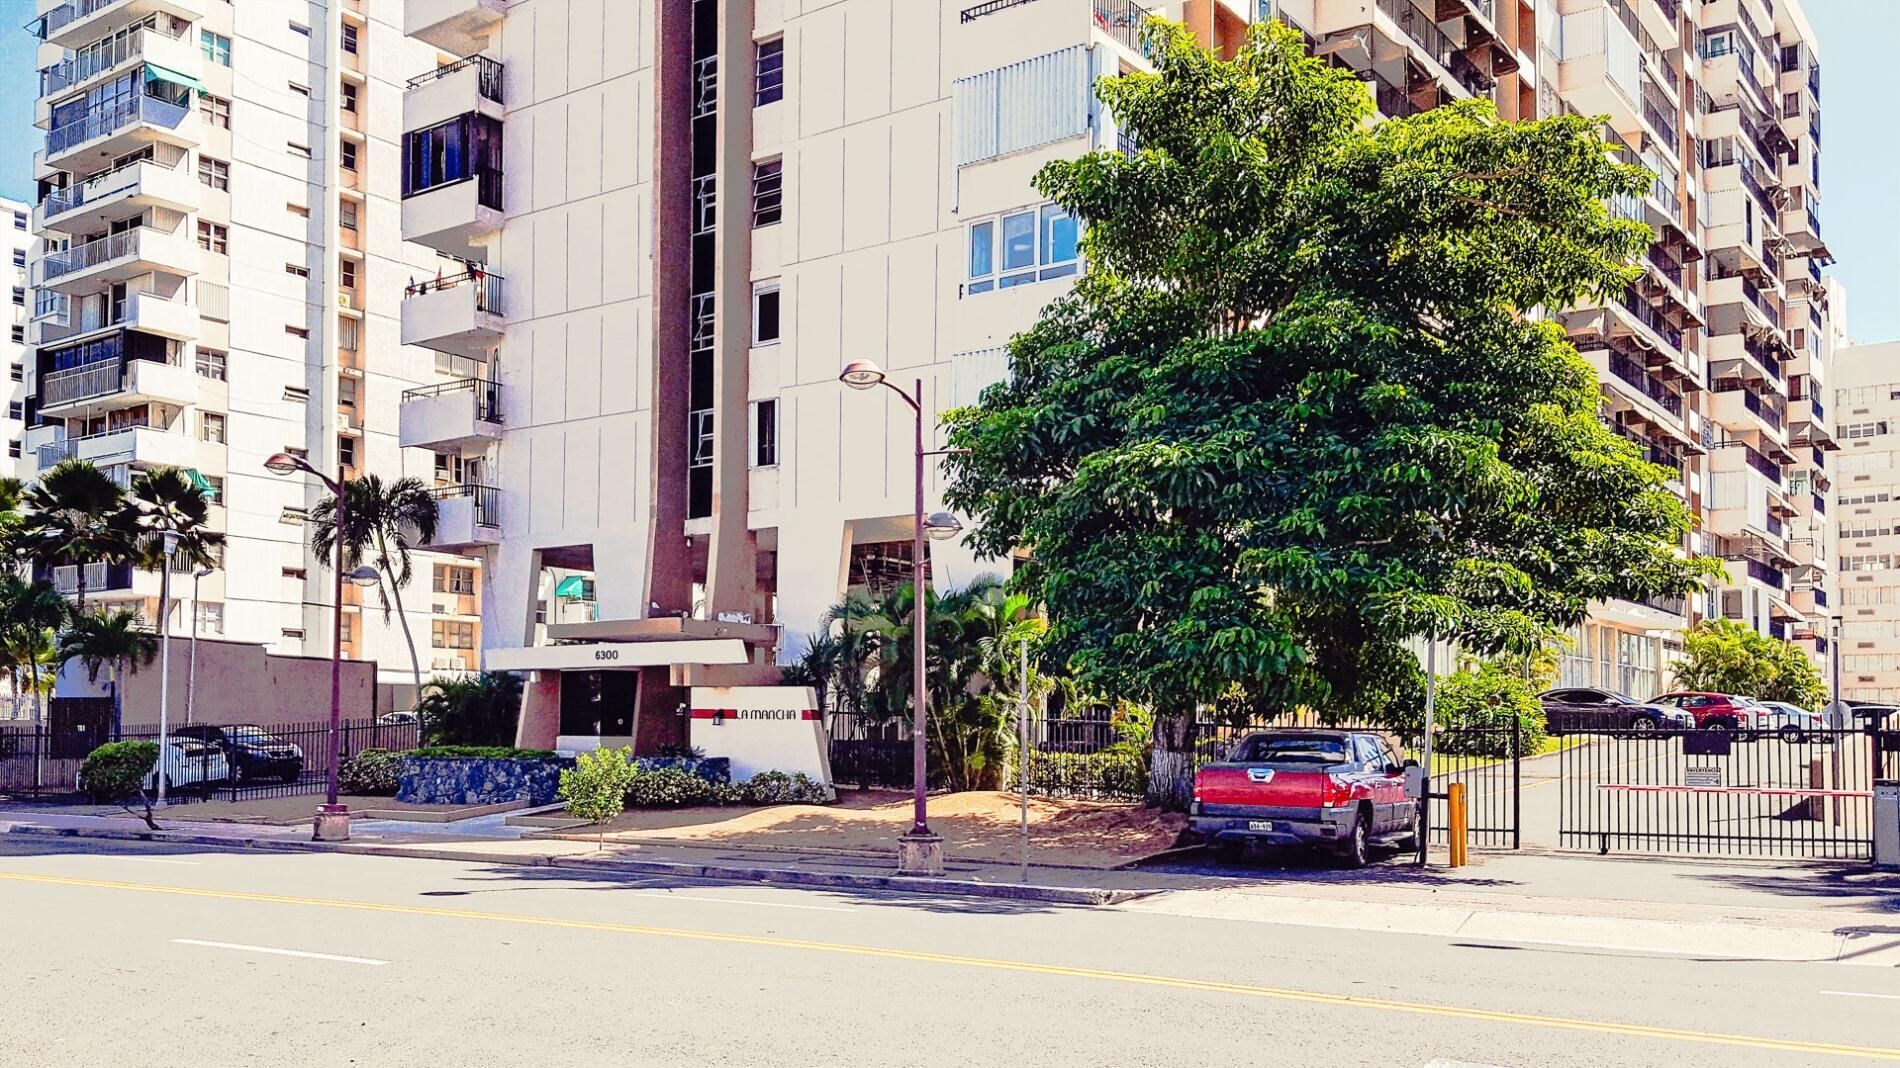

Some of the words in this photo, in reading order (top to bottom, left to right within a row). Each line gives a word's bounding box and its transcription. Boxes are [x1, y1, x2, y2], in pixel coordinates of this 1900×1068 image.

[595, 650, 618, 660] 6300
[736, 709, 748, 720] LA
[750, 709, 796, 720] MANCHA
